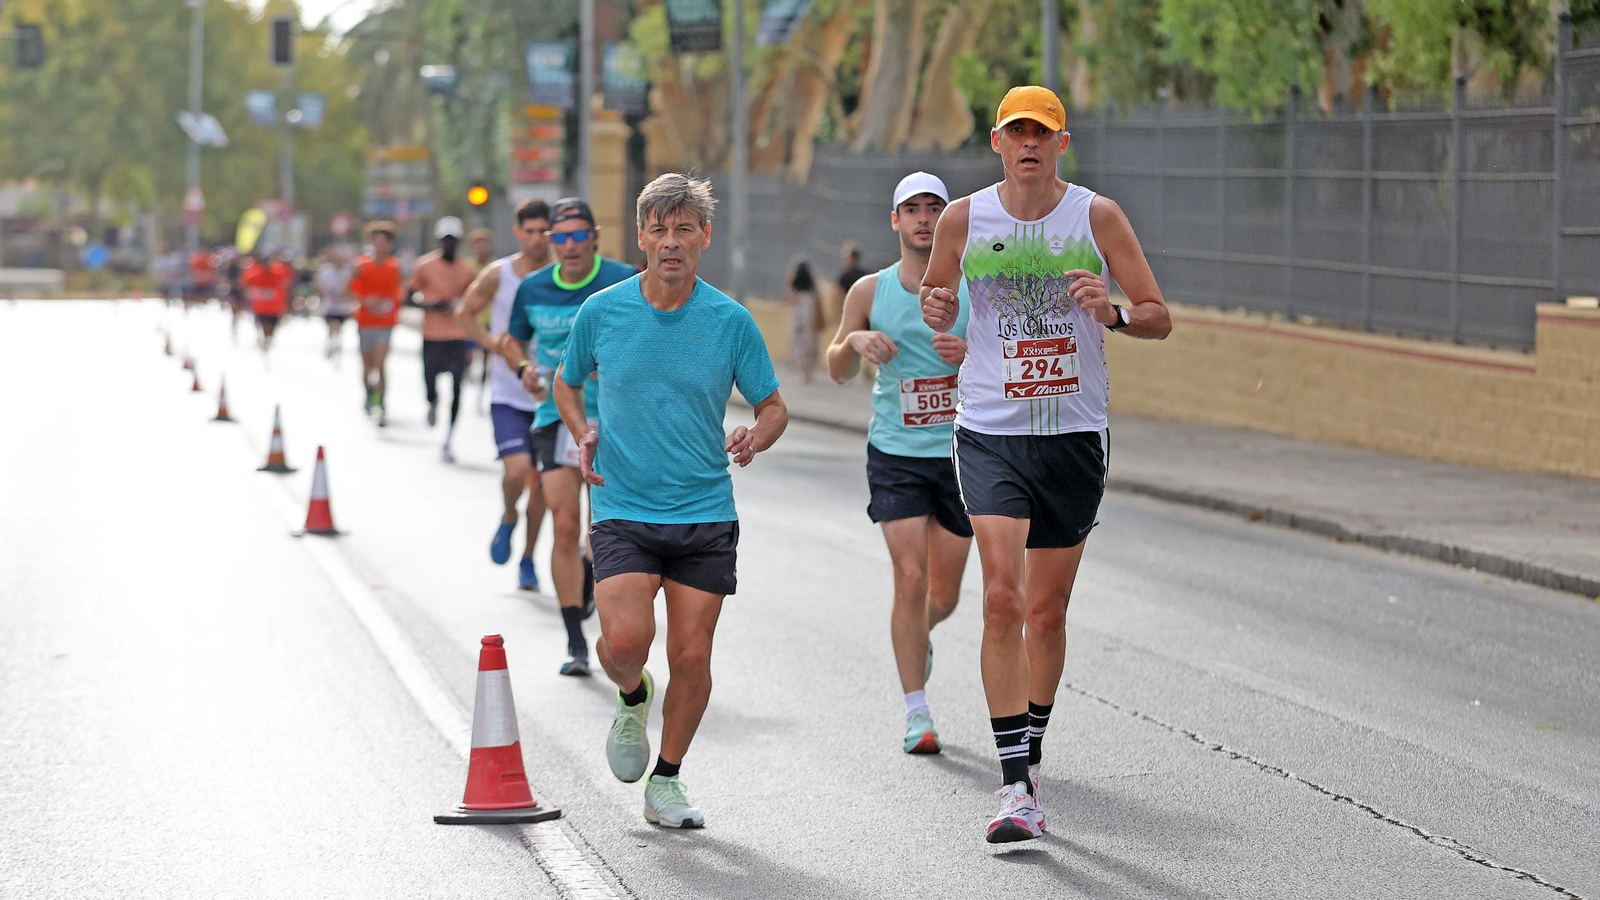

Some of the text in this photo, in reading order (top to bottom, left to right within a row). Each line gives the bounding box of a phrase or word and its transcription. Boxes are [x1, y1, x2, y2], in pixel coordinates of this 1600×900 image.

[997, 314, 1074, 340] Los Olivos
[1021, 357, 1064, 380] 294
[917, 392, 952, 410] 505
